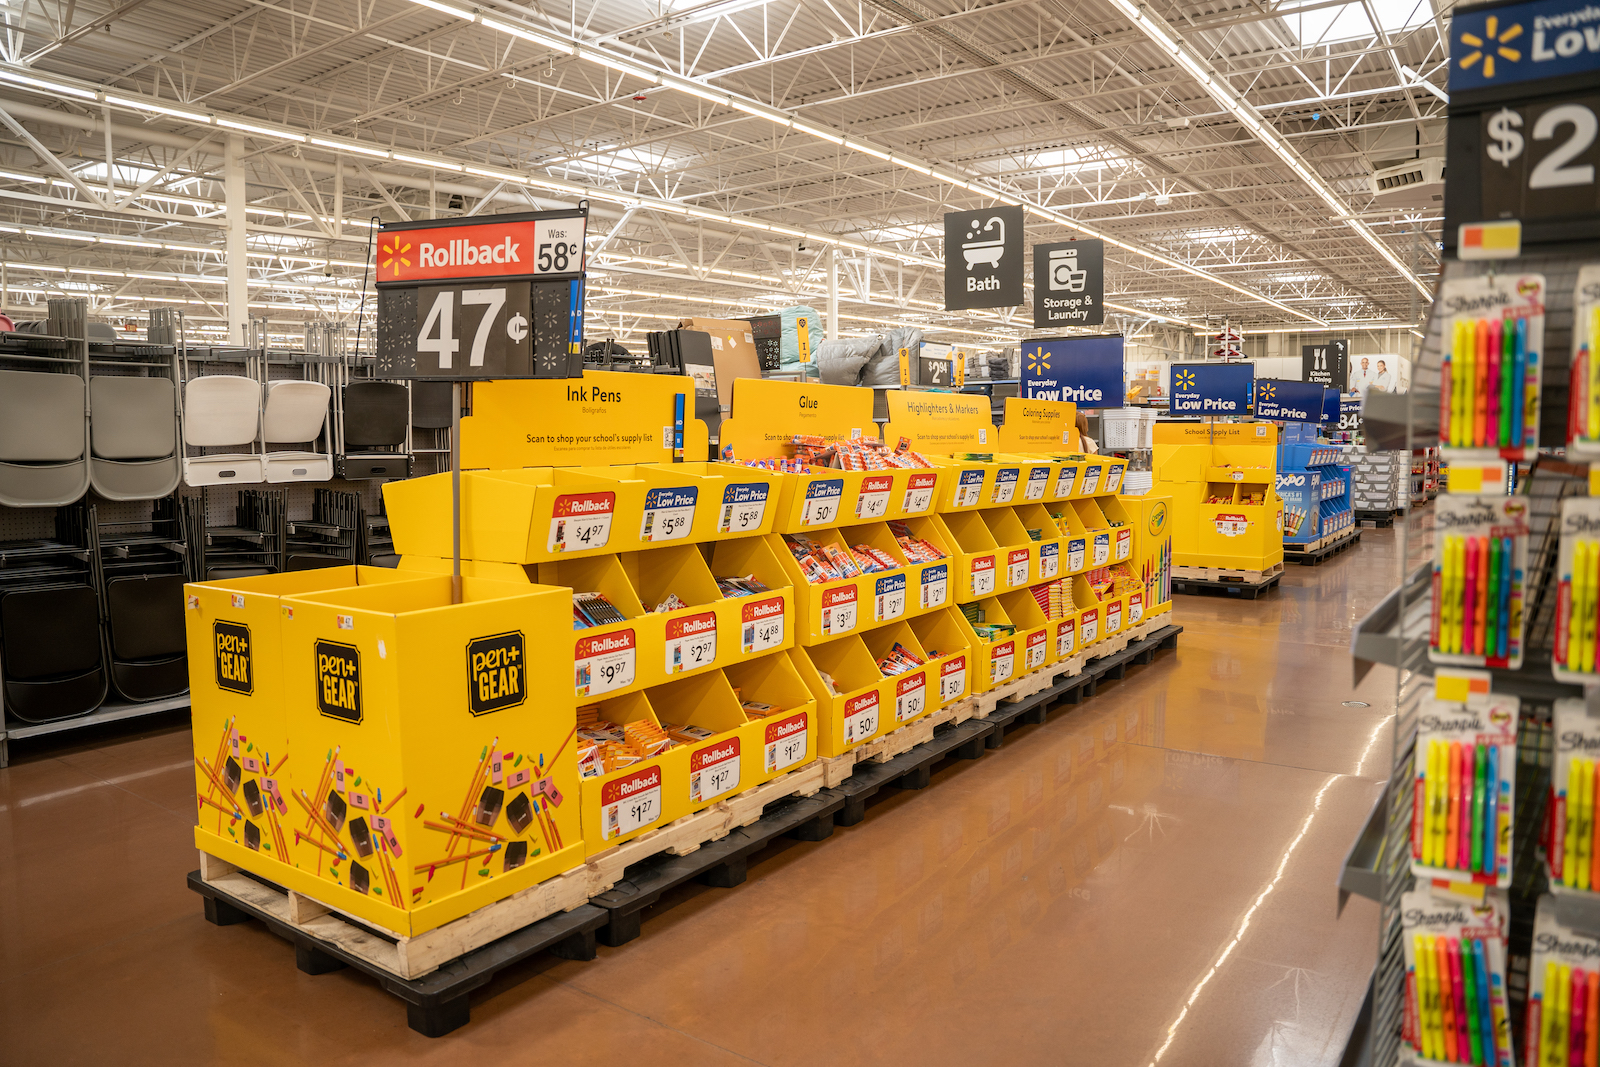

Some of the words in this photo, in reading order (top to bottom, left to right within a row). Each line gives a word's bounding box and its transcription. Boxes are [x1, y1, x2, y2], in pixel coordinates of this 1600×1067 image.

[547, 229, 568, 239] Was:
[419, 236, 520, 268] Rollback
[537, 241, 578, 272] 58¢
[966, 275, 1000, 292] Bath
[1044, 297, 1082, 309] Storage
[1084, 295, 1093, 306] &
[1048, 309, 1089, 321] Laundry
[417, 288, 529, 369] 47¢
[1027, 379, 1057, 388] Everyday
[567, 385, 588, 402] Ink
[592, 386, 622, 403] Pens
[1027, 387, 1060, 401] Low
[1062, 385, 1103, 402] Price
[799, 395, 818, 409] Glue
[907, 401, 948, 416] Highlighters
[949, 402, 955, 414] &
[955, 404, 979, 415] Markers
[1175, 398, 1202, 410] Low
[1203, 397, 1237, 410] Price
[1022, 407, 1042, 420] Coloring
[1043, 408, 1061, 420] Supplies
[1257, 406, 1280, 417] Low
[1280, 408, 1308, 420] Price
[526, 433, 545, 444] Scan
[546, 434, 555, 443] to
[556, 433, 574, 445] shop
[575, 435, 592, 445] your
[592, 433, 621, 443] school's
[621, 433, 643, 444] supply
[643, 433, 653, 443] list
[764, 433, 776, 441] Scan
[867, 480, 889, 491] Rollback
[915, 478, 934, 487] Rollback
[734, 491, 751, 502] Low
[750, 490, 766, 500] Price
[814, 486, 827, 497] Low
[826, 485, 841, 496] Price
[571, 499, 610, 513] Rollback
[657, 496, 676, 508] Low
[675, 494, 694, 506] Price
[975, 559, 992, 570] Rollback
[831, 590, 855, 604] Rollback
[753, 601, 781, 617] Rollback
[683, 617, 715, 634] Rollback
[591, 634, 630, 653] Rollback
[996, 645, 1013, 656] Rollback
[945, 660, 963, 674] Rollback
[902, 676, 923, 692] Rollback
[854, 694, 877, 712] Rollback
[777, 718, 805, 737] Rollback
[702, 744, 734, 766] Rollback
[620, 772, 658, 796] Rollback
